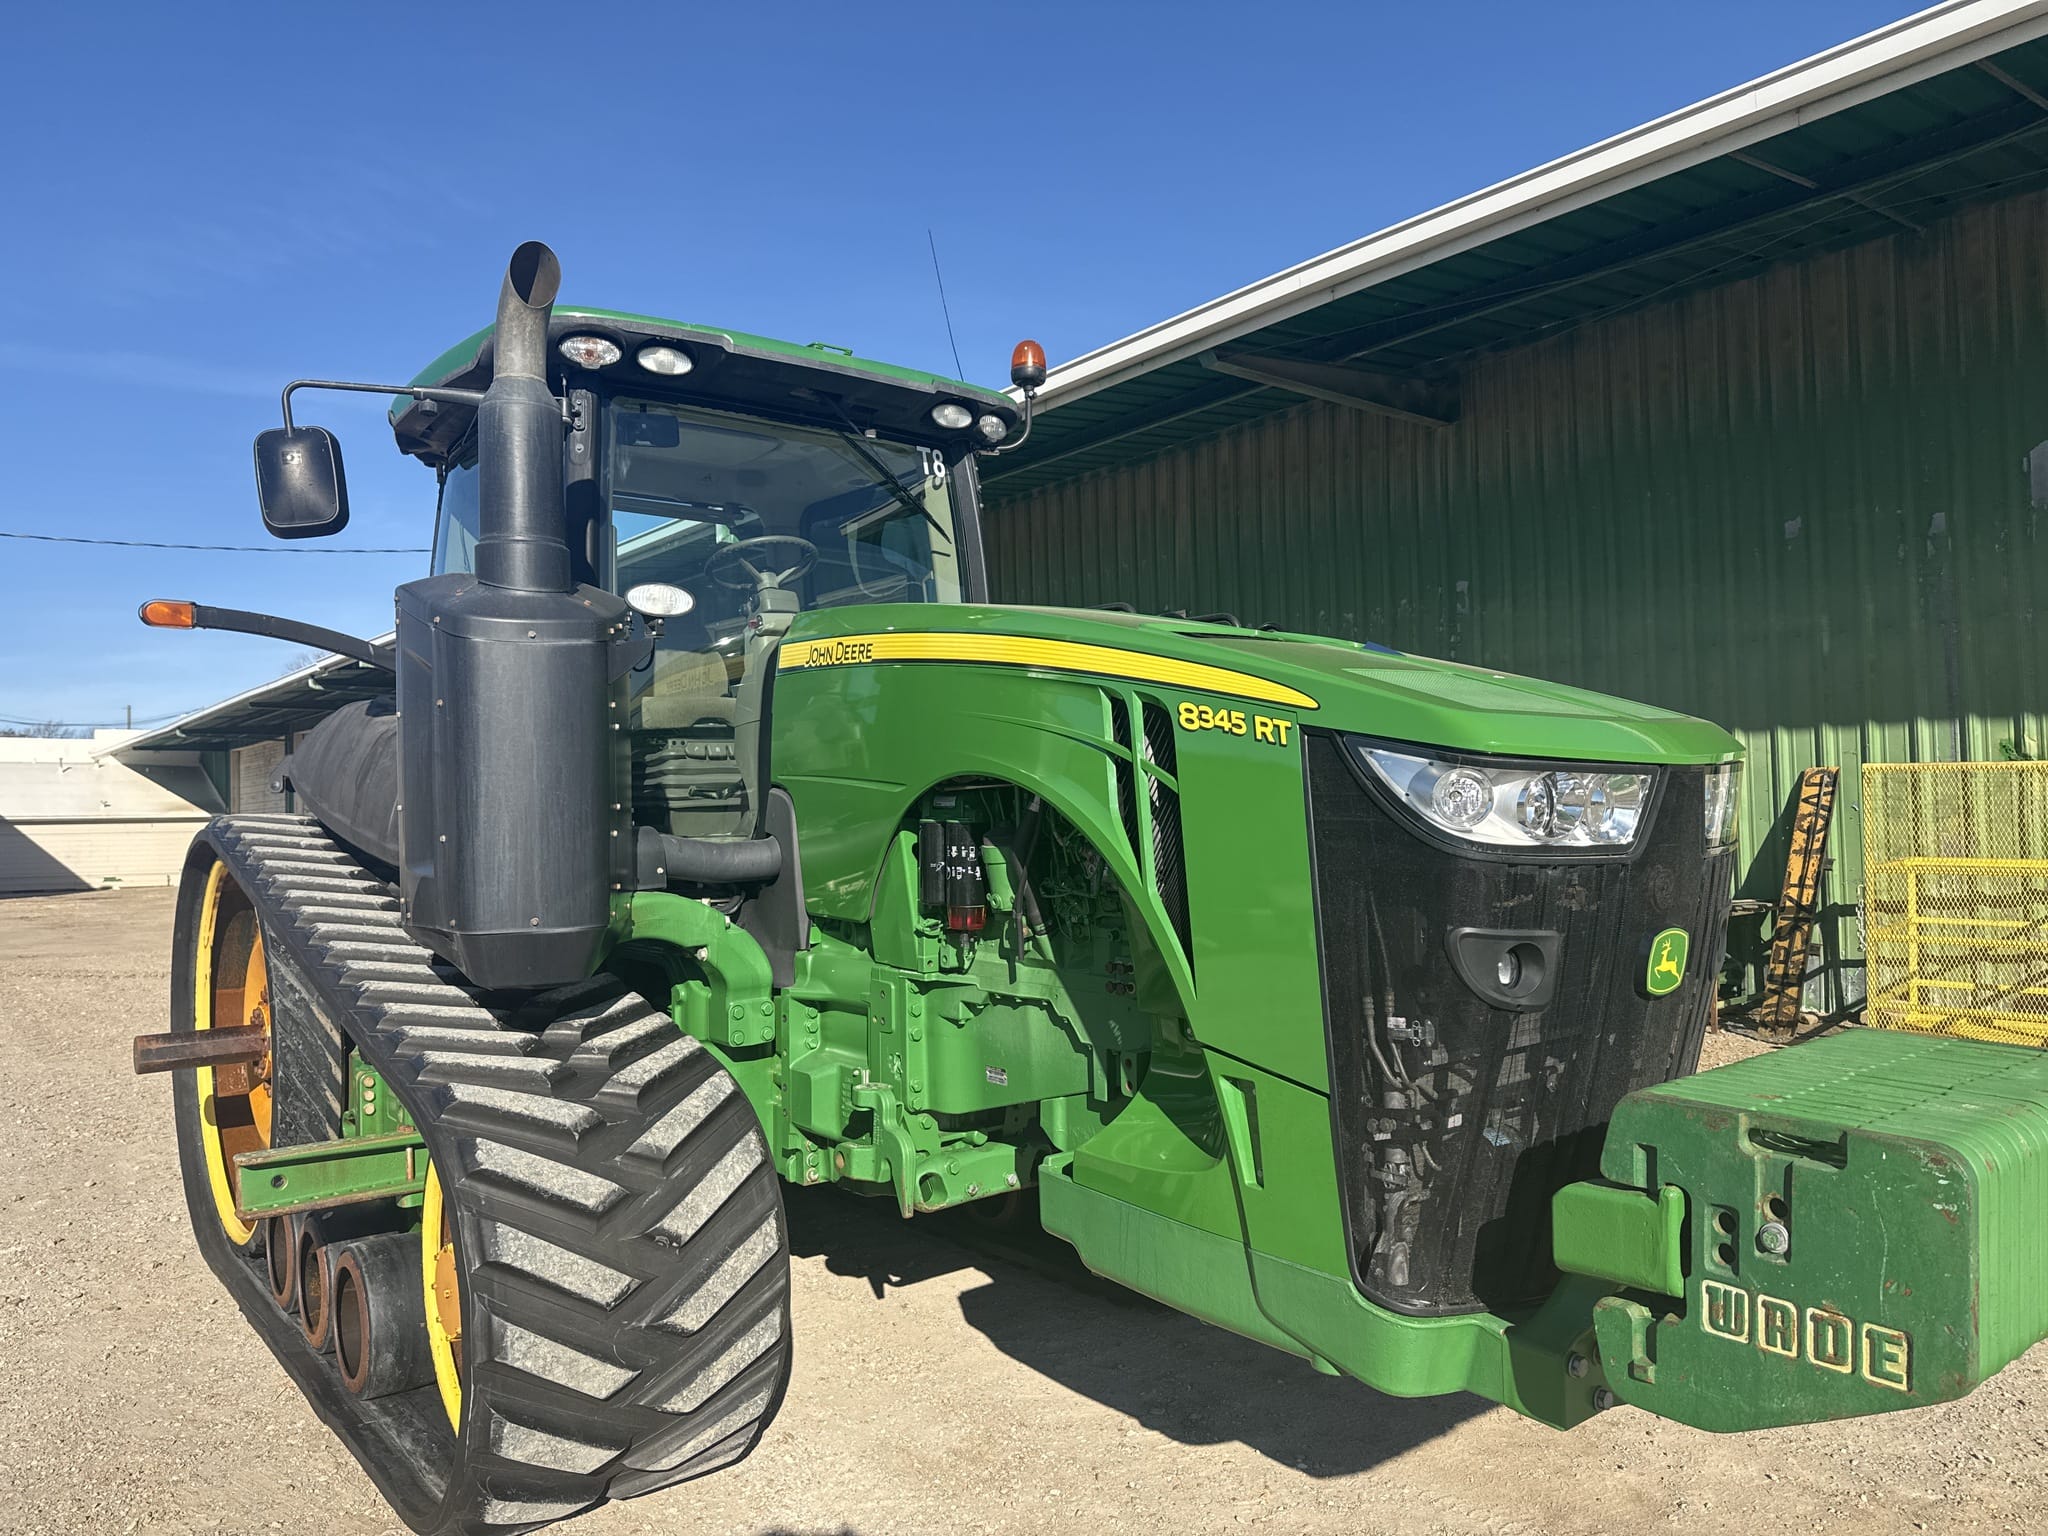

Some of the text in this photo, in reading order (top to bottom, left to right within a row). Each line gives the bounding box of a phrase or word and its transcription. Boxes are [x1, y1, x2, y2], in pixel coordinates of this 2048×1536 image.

[916, 446, 945, 478] T8
[805, 641, 873, 666] JOHN DEERE
[1178, 701, 1292, 747] 8345 RT
[1702, 1279, 1912, 1392] WADE
